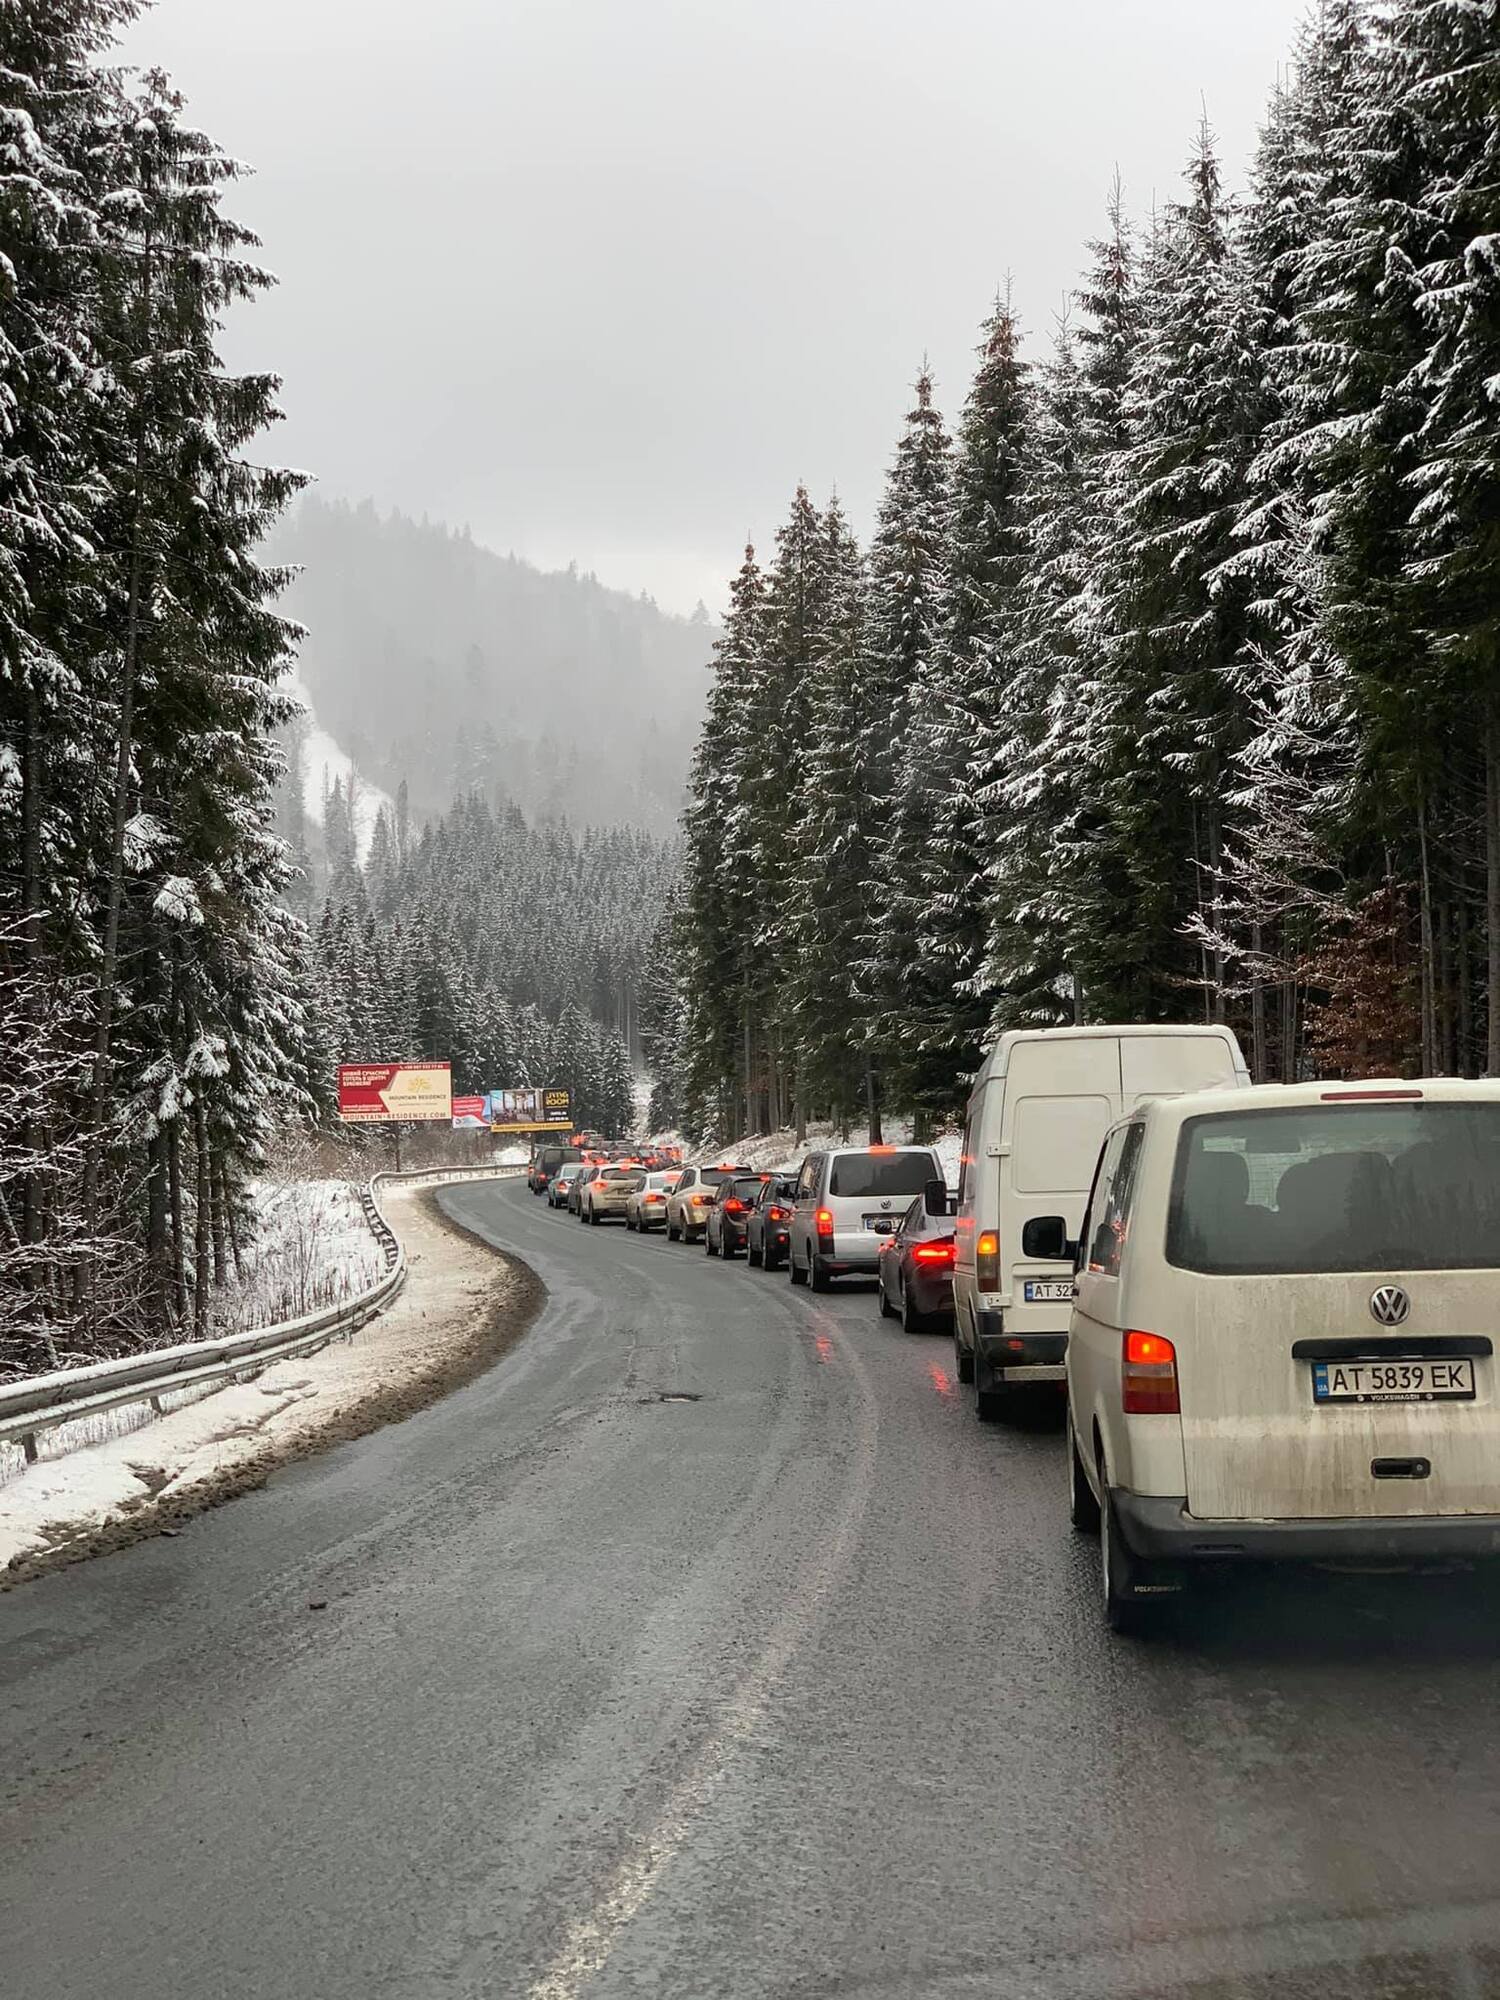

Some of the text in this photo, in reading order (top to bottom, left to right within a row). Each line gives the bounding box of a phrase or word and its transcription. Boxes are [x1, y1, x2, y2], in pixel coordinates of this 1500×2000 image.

[1035, 1284, 1053, 1298] AT
[1332, 1365, 1464, 1391] AT 5839 EK
[1371, 1393, 1420, 1401] VOLKSWAGEN
